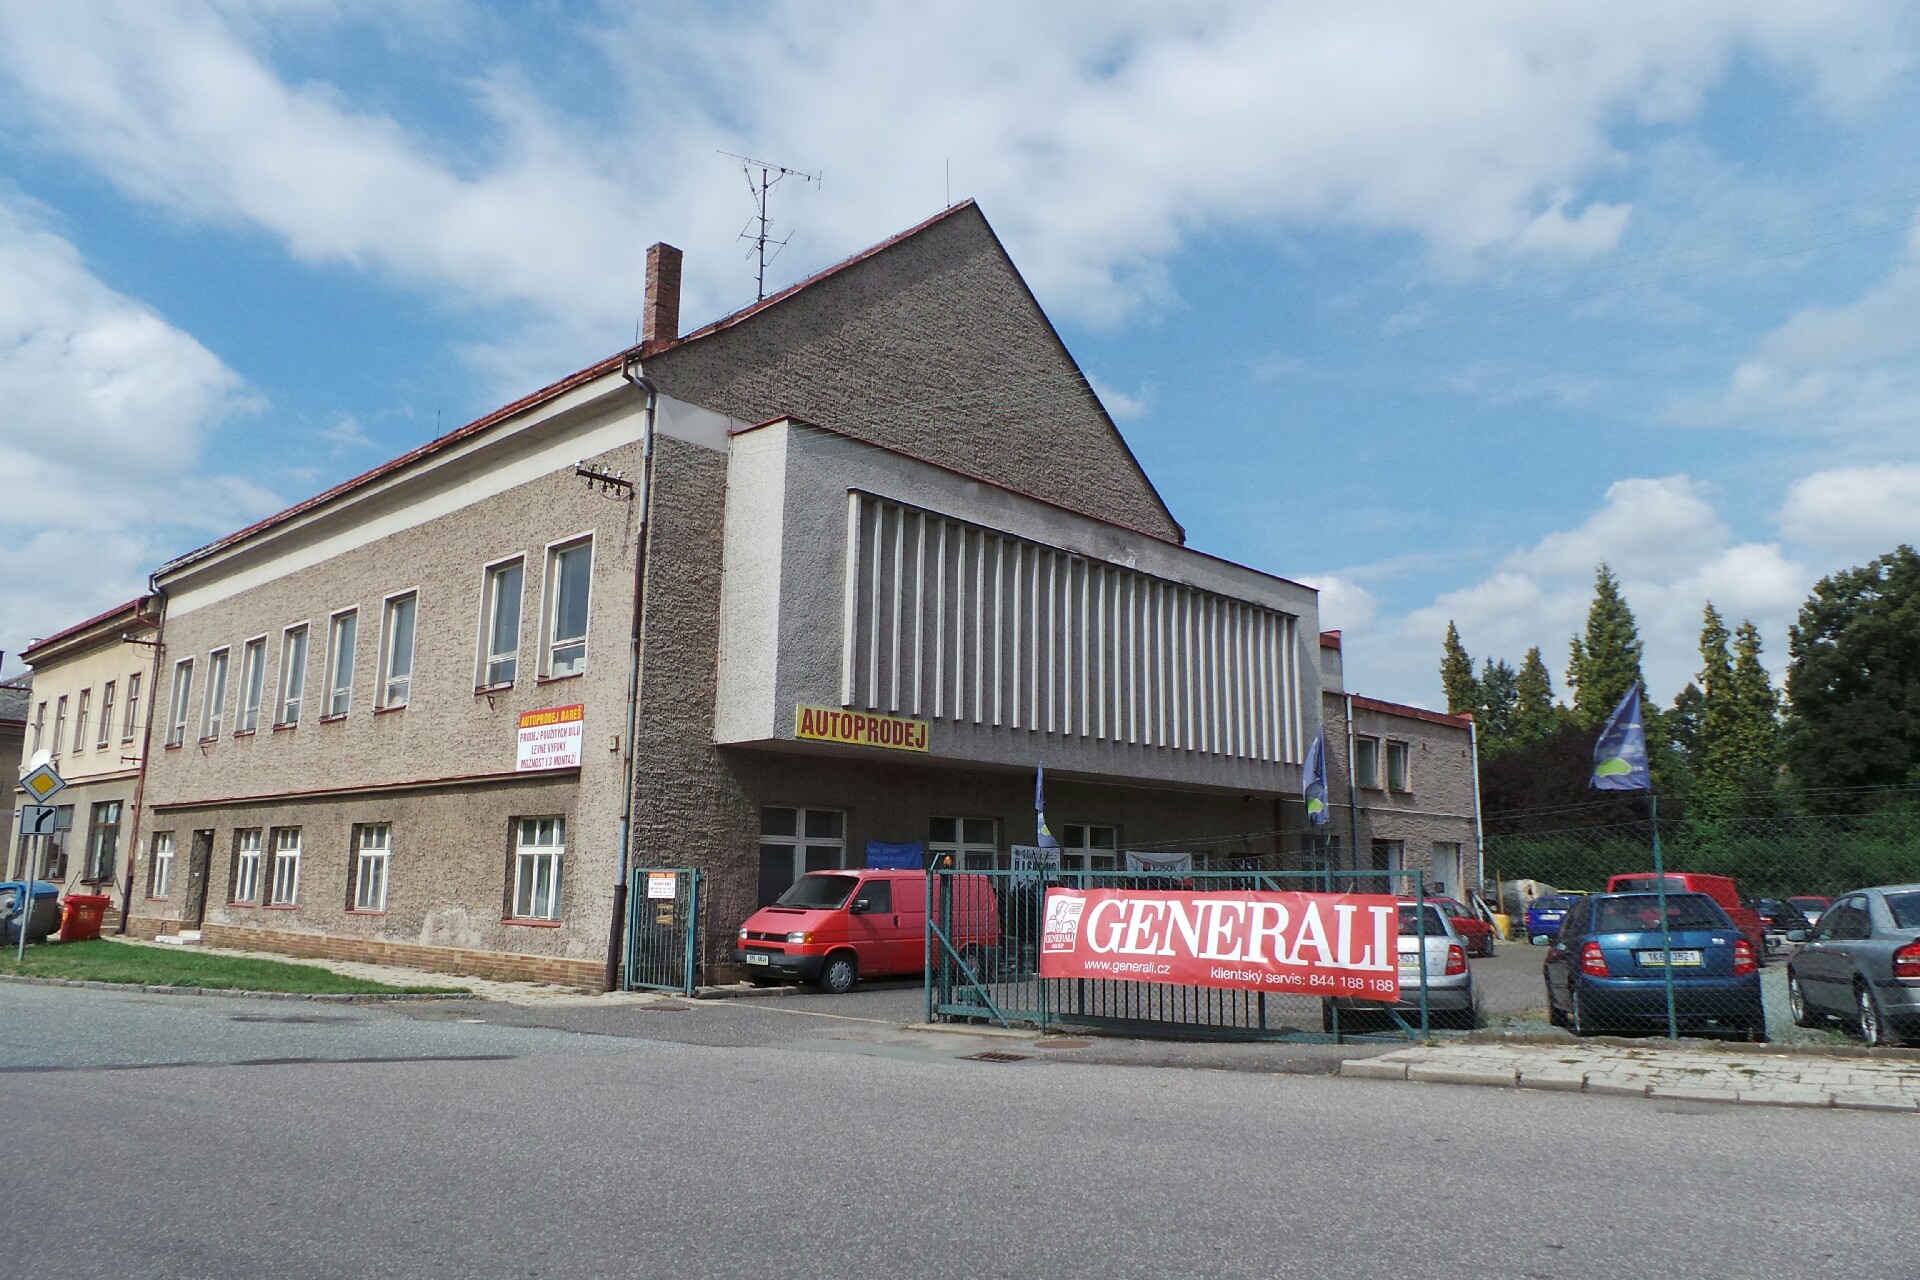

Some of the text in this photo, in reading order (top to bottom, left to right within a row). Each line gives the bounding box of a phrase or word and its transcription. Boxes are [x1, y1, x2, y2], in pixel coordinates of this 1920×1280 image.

[520, 711, 559, 727] AUTOPRODEJ
[801, 708, 926, 748] AUTOPRODEJ
[520, 730, 540, 743] PRODEJ
[1045, 933, 1075, 943] GENERALI
[1087, 899, 1393, 971] GENERALI
[1084, 959, 1171, 975] www.generali.cz
[1211, 967, 1394, 993] klientský servis: 844 188 188
